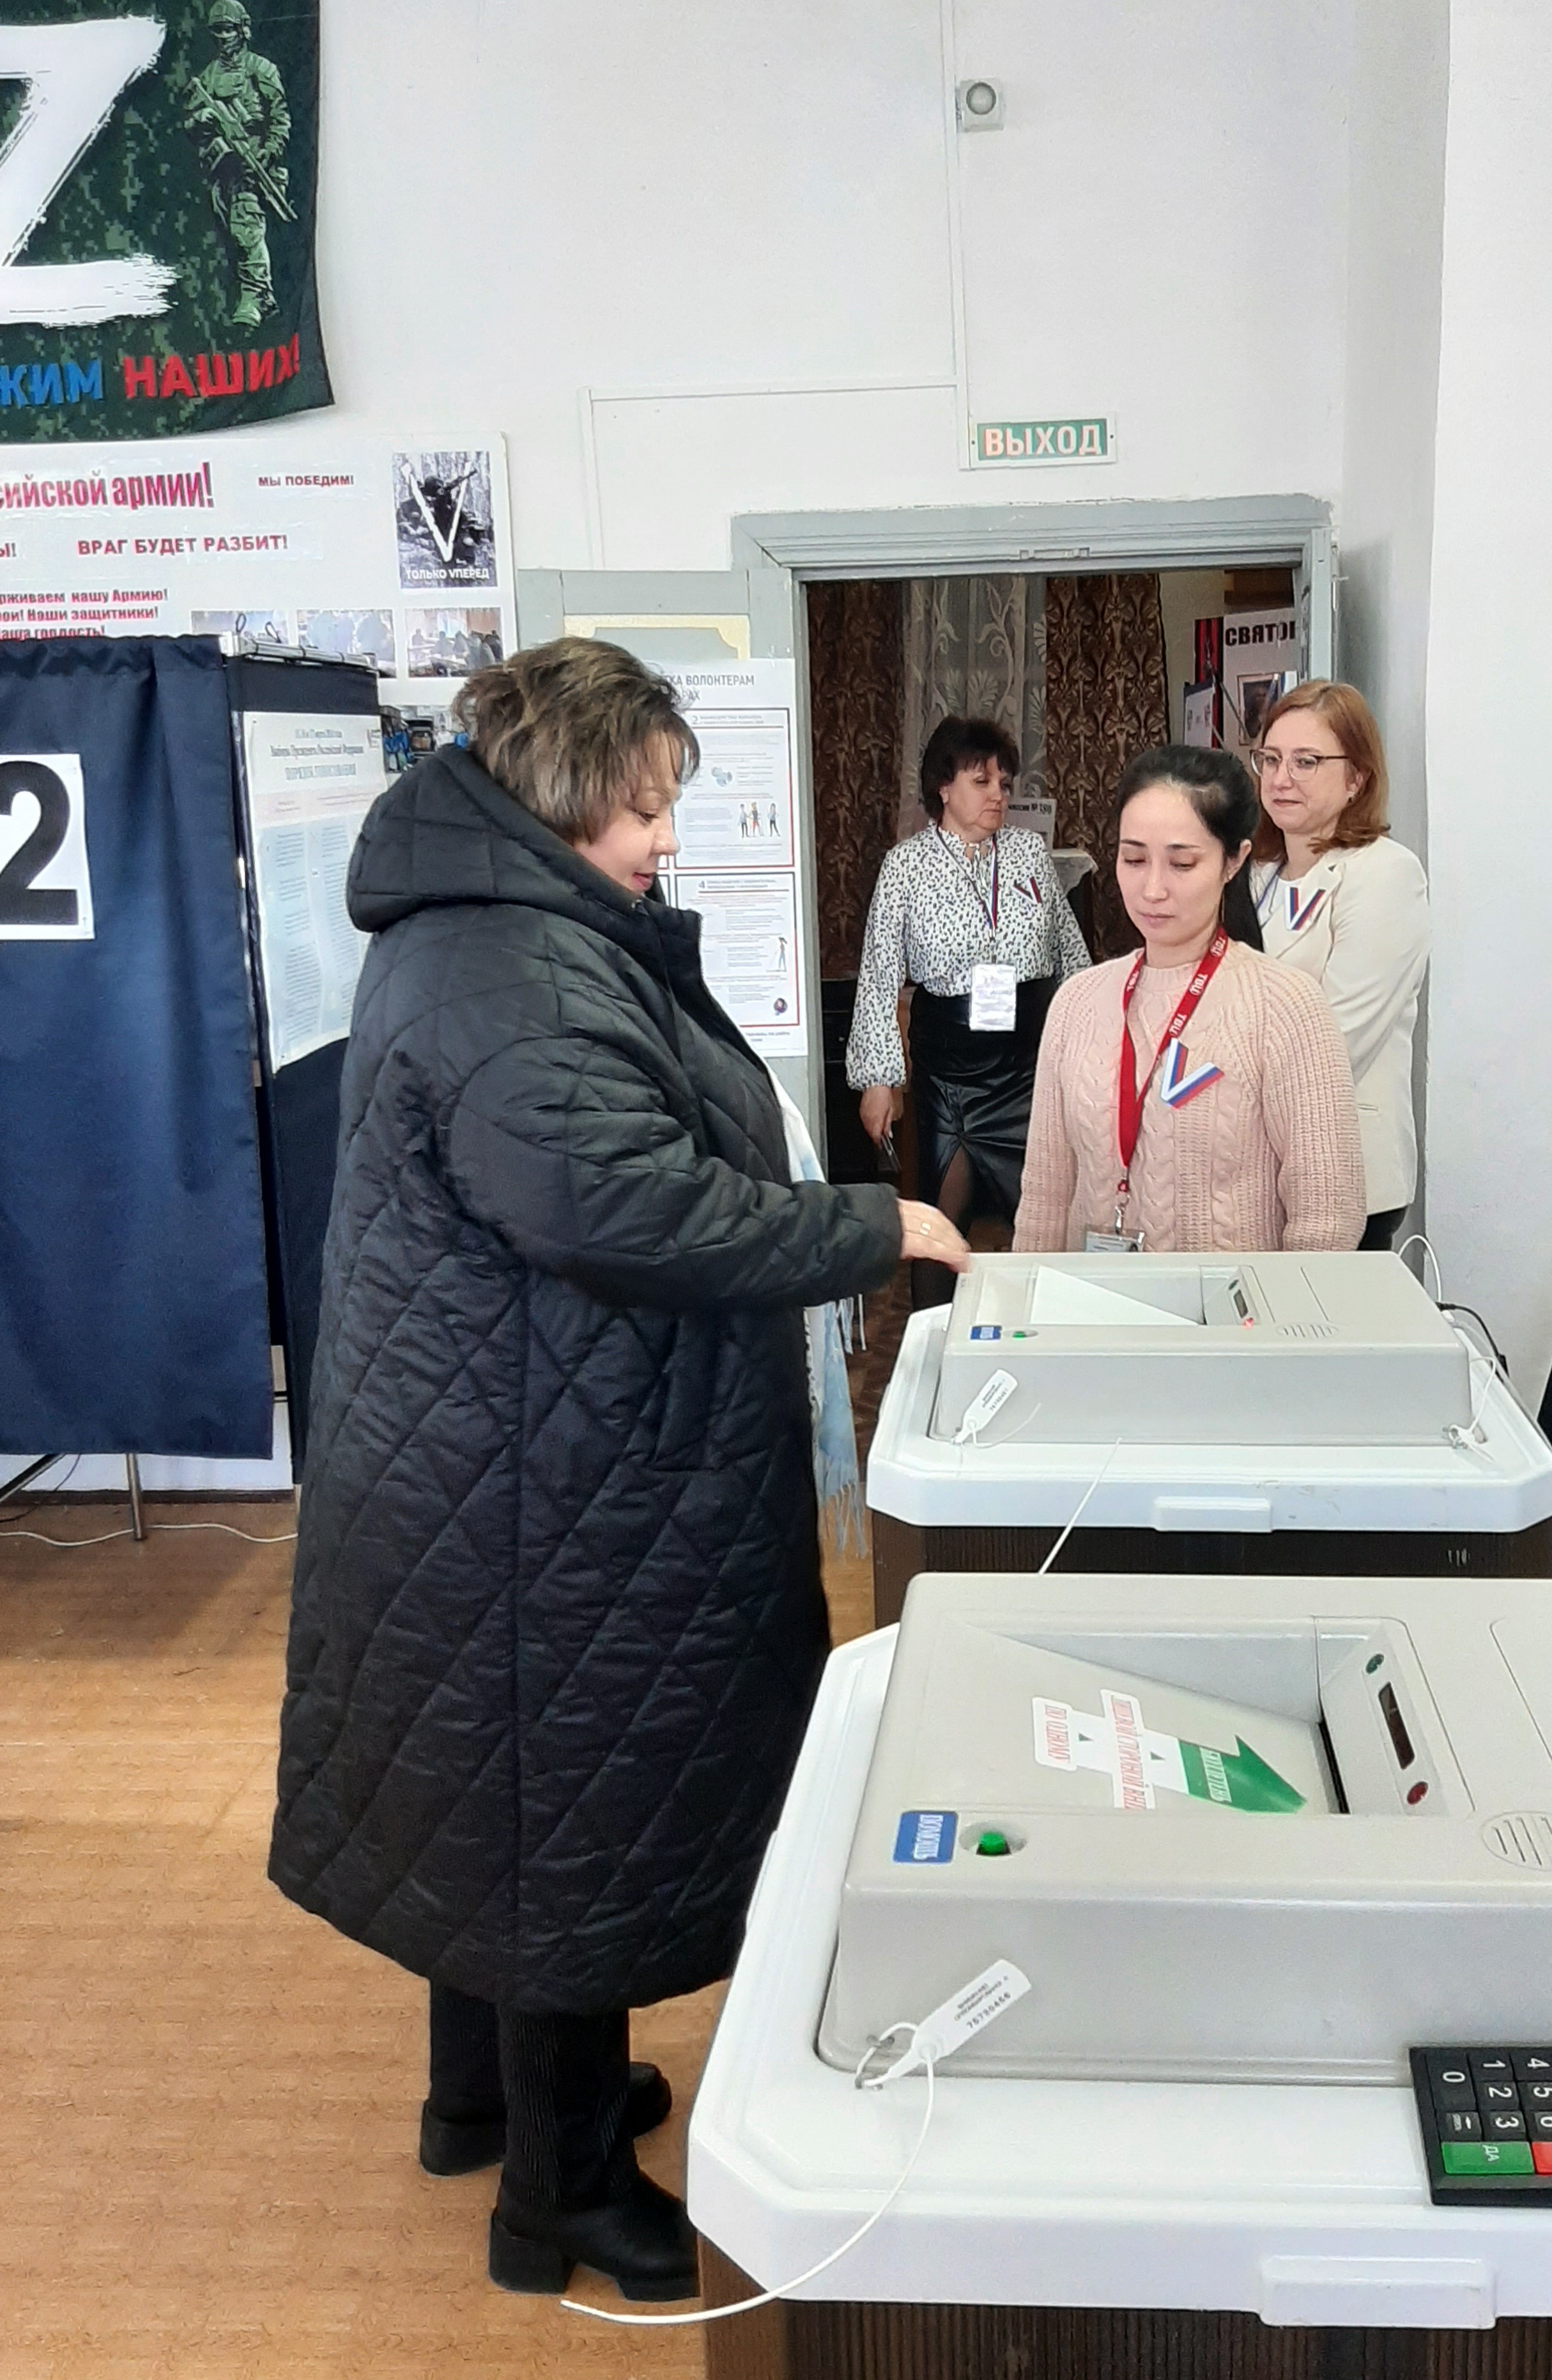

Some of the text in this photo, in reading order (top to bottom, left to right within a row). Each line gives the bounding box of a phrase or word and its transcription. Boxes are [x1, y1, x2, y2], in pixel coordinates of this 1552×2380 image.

[123, 334, 300, 398] НАШИХ!
[983, 424, 1102, 457] ВЫХОД
[112, 461, 215, 510] армии!
[258, 474, 354, 488] МЫ ПОБЕДИМ!
[78, 534, 288, 556] ВРАГ БУДЕТ РАЗБИТ!
[406, 569, 447, 580] ТОЛЬКО
[72, 591, 109, 603] нашу
[111, 589, 168, 603] Армию!
[0, 607, 158, 622] ои! Наши защитники!
[686, 674, 755, 686] ВОЛОНТЕРАМ
[0, 761, 79, 925] 2
[1527, 2057, 1551, 2069] 4
[1443, 2071, 1466, 2083] 0
[1483, 2059, 1519, 2129] 1 2 3
[1482, 2144, 1500, 2162] ДА
